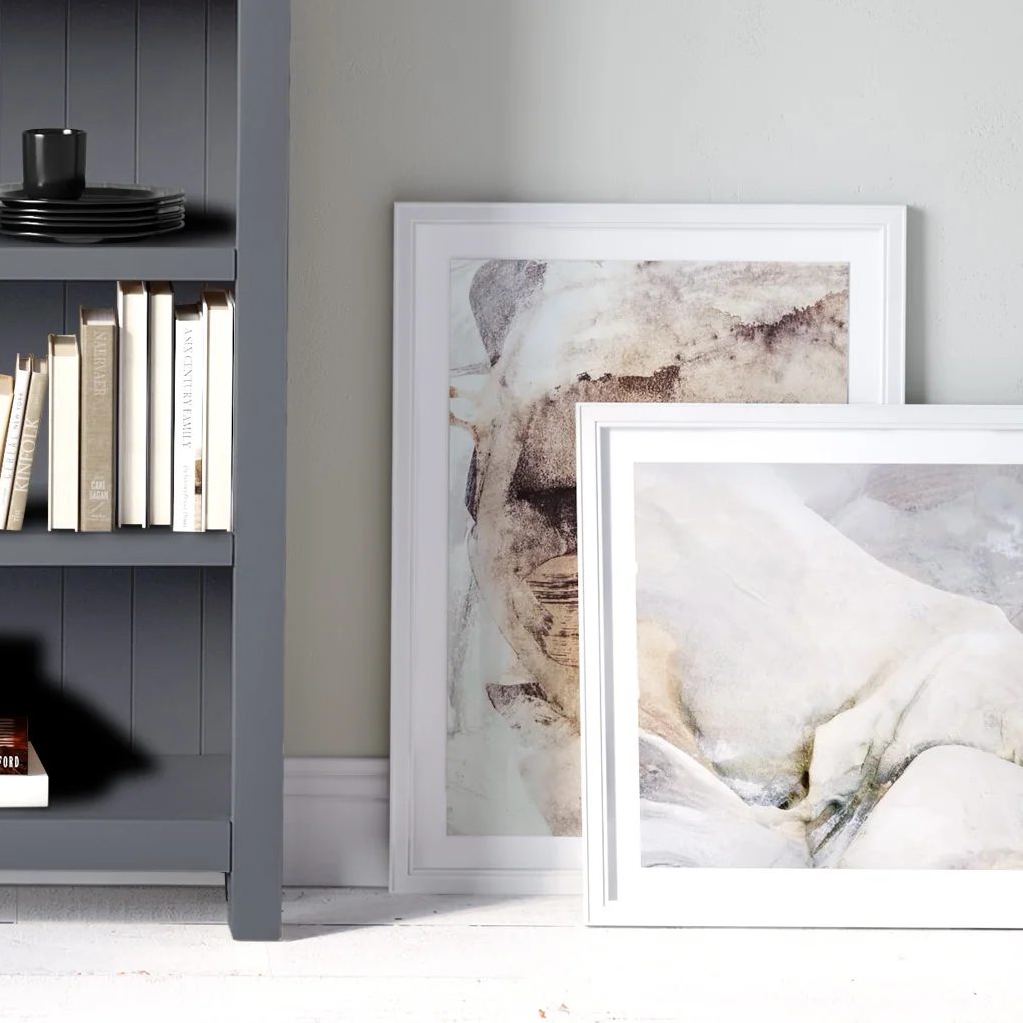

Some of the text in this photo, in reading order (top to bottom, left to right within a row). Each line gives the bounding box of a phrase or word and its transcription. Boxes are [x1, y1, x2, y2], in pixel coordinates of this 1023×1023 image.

[183, 355, 193, 406] CENTURY
[3, 437, 18, 479] CEREAL
[12, 413, 20, 430] NEW
[16, 392, 24, 410] YORK
[182, 409, 192, 448] FAMILY
[14, 418, 39, 492] KINFOLK
[88, 490, 109, 500] SAGAN
[91, 480, 106, 490] CARL
